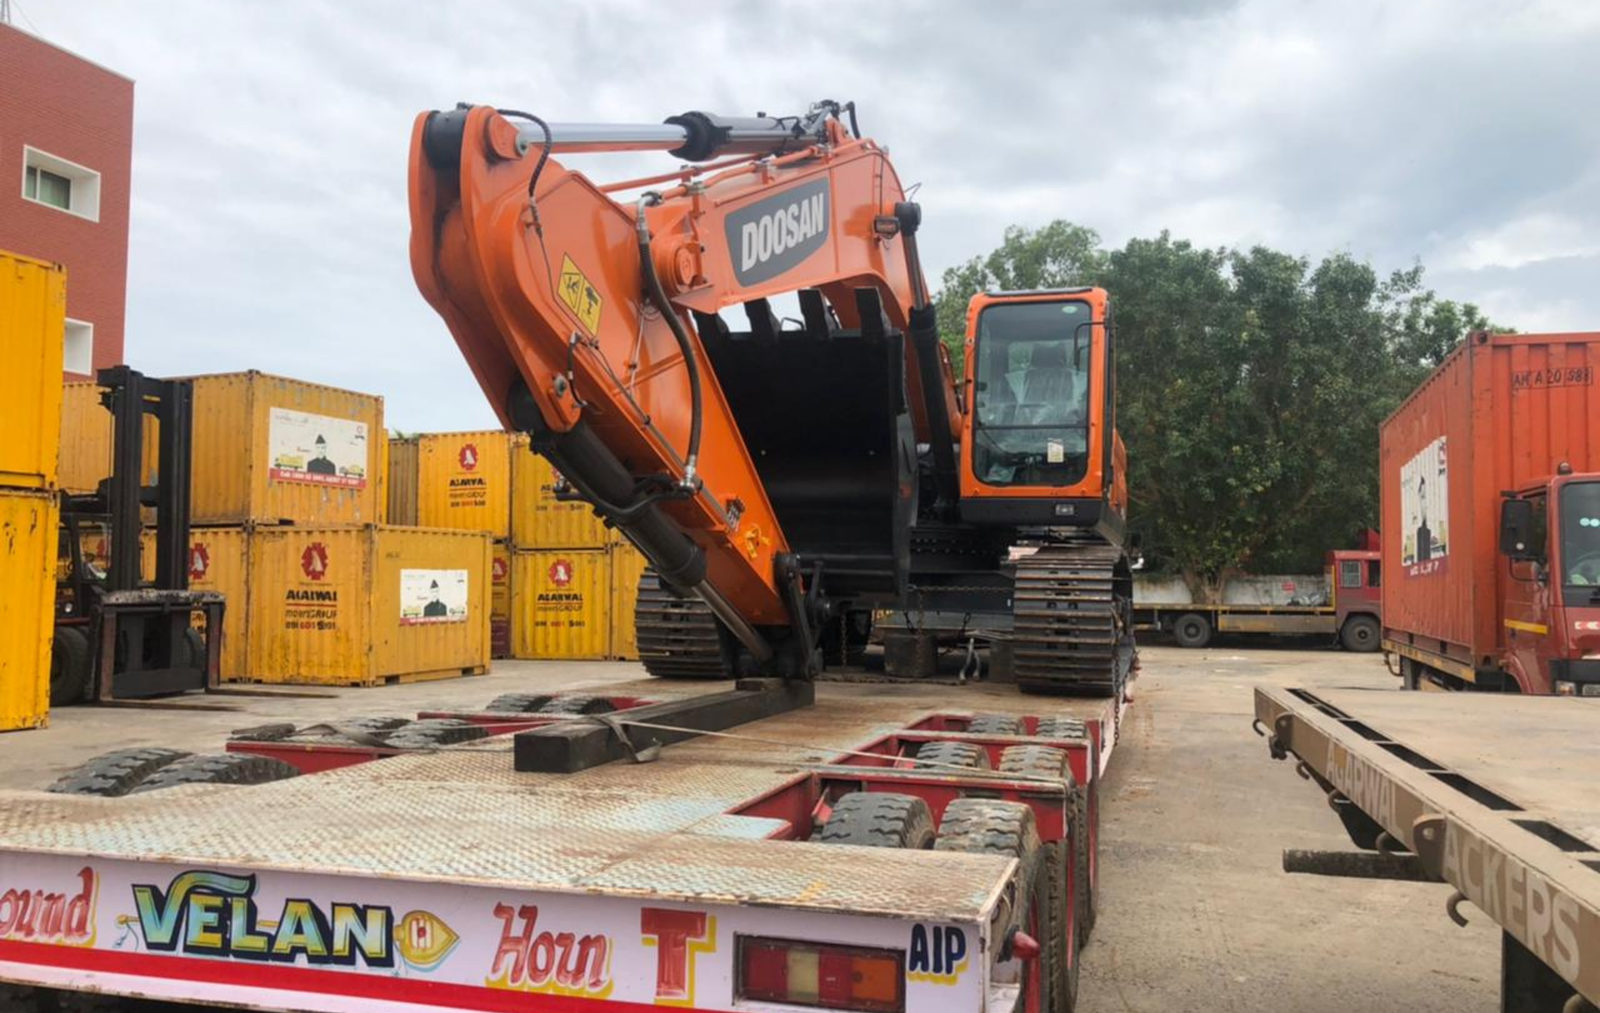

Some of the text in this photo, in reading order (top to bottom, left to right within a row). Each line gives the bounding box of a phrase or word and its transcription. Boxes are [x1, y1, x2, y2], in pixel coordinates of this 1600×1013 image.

[741, 192, 824, 272] DOOSAN
[132, 871, 394, 967] VELAN
[489, 901, 612, 993] Horn
[908, 923, 967, 979] AIP
[1424, 803, 1580, 984] ACKERS
